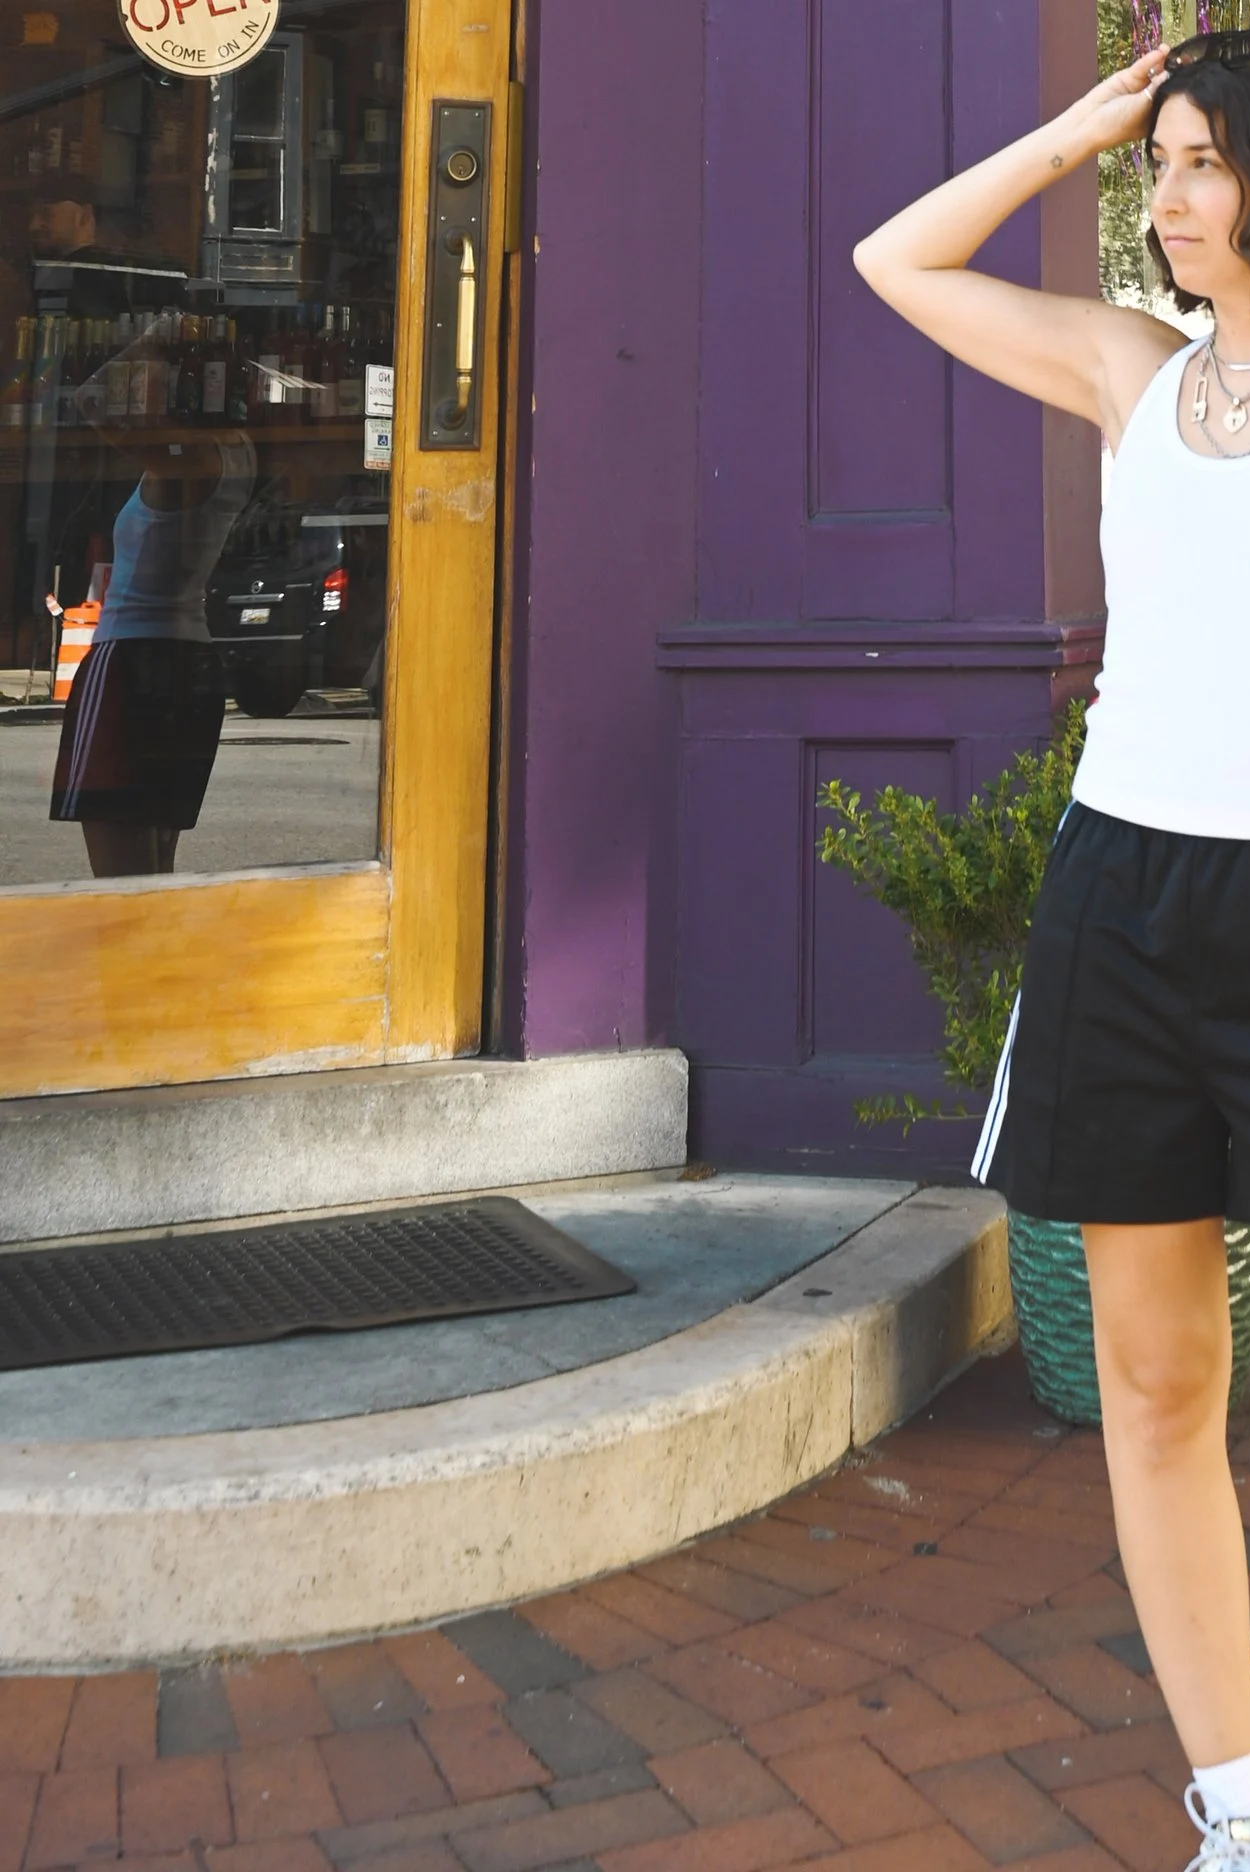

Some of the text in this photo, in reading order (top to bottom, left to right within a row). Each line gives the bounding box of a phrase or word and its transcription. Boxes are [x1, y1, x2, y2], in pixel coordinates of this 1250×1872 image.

[161, 20, 259, 62] COME ON IN
